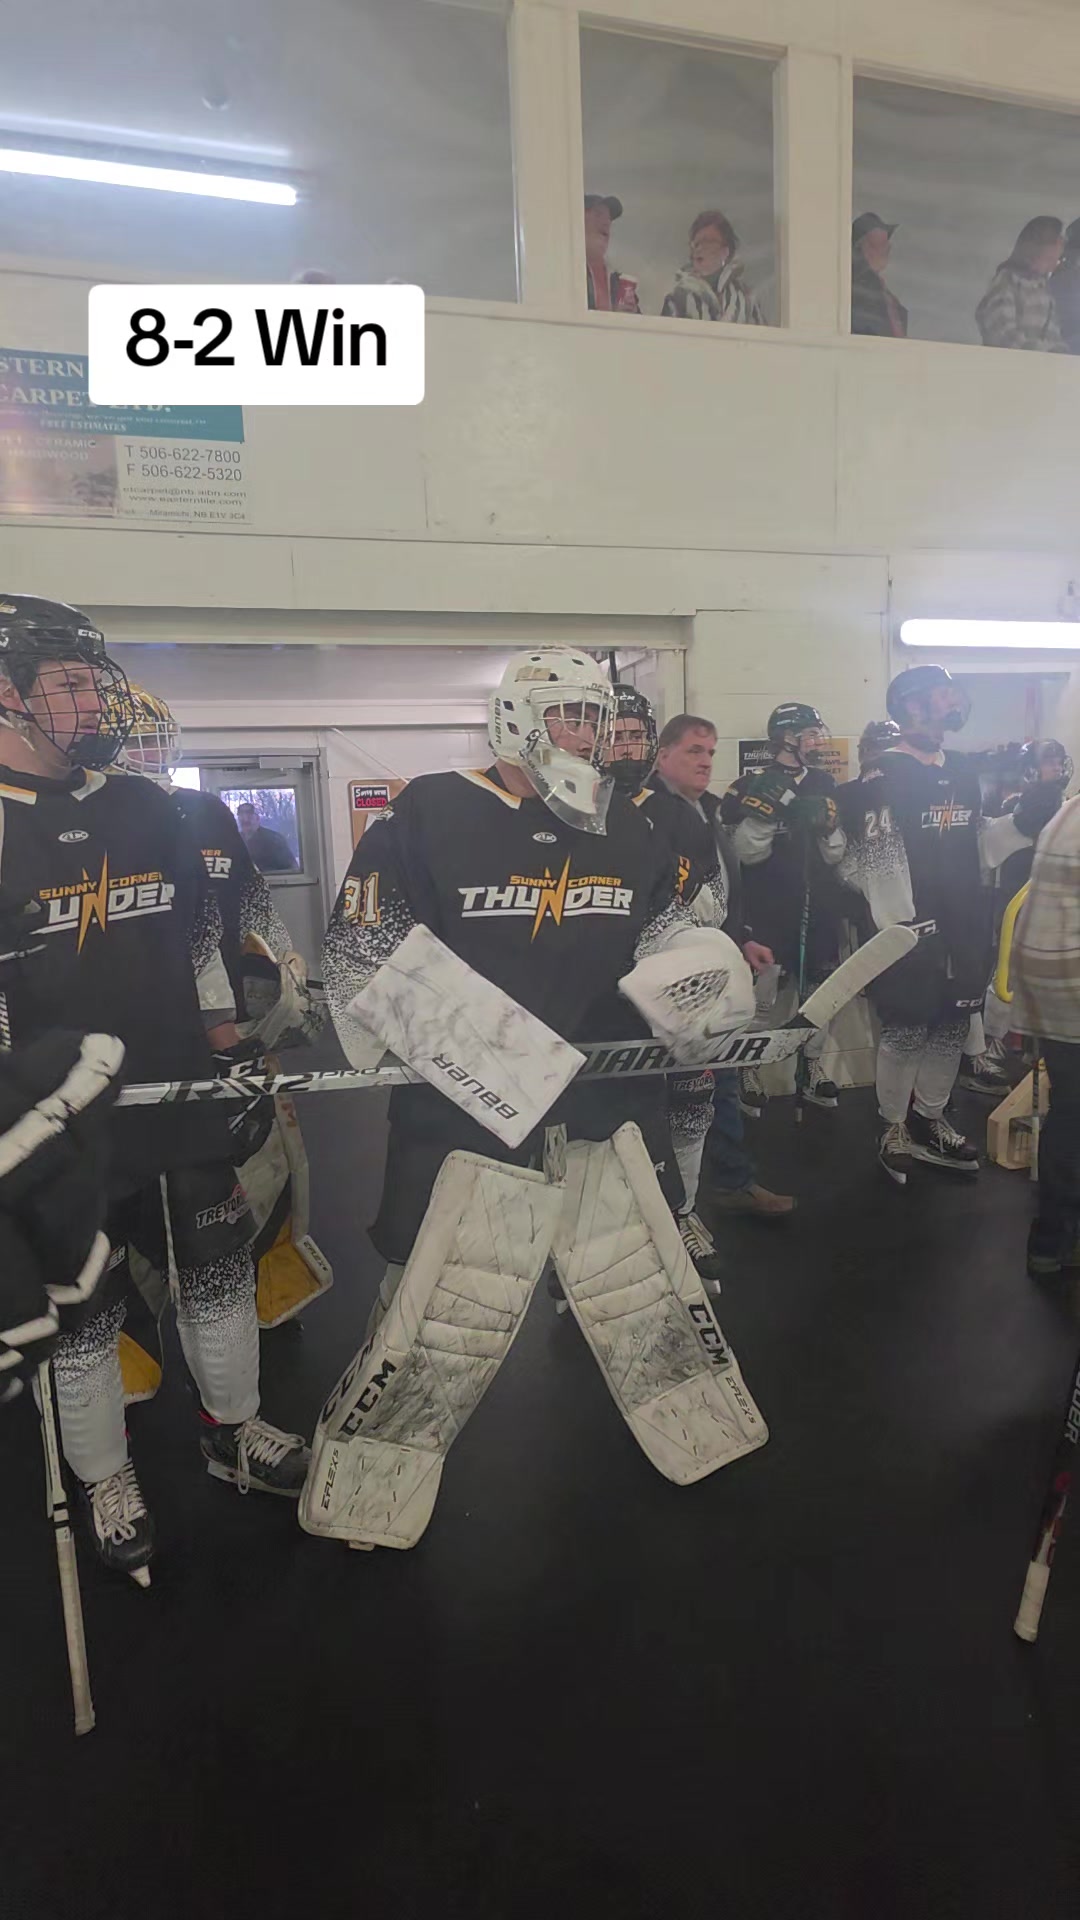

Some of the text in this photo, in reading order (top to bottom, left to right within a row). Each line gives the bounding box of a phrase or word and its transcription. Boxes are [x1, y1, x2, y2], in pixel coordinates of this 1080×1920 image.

[0, 384, 97, 408] ARPE
[70, 421, 127, 432] ESTIMATES
[124, 444, 241, 464] T 506-622-7800
[126, 463, 242, 482] F 506-622-5320
[356, 797, 388, 808] CLOSED
[865, 806, 892, 838] 24
[39, 881, 97, 900] SUNNY
[510, 875, 622, 888] SUNNY CORNER
[458, 884, 633, 943] THUNDER
[318, 1066, 381, 1080] PRO
[431, 1052, 519, 1119] BAUER
[687, 1300, 729, 1366] CCM
[338, 1357, 397, 1437] CCM
